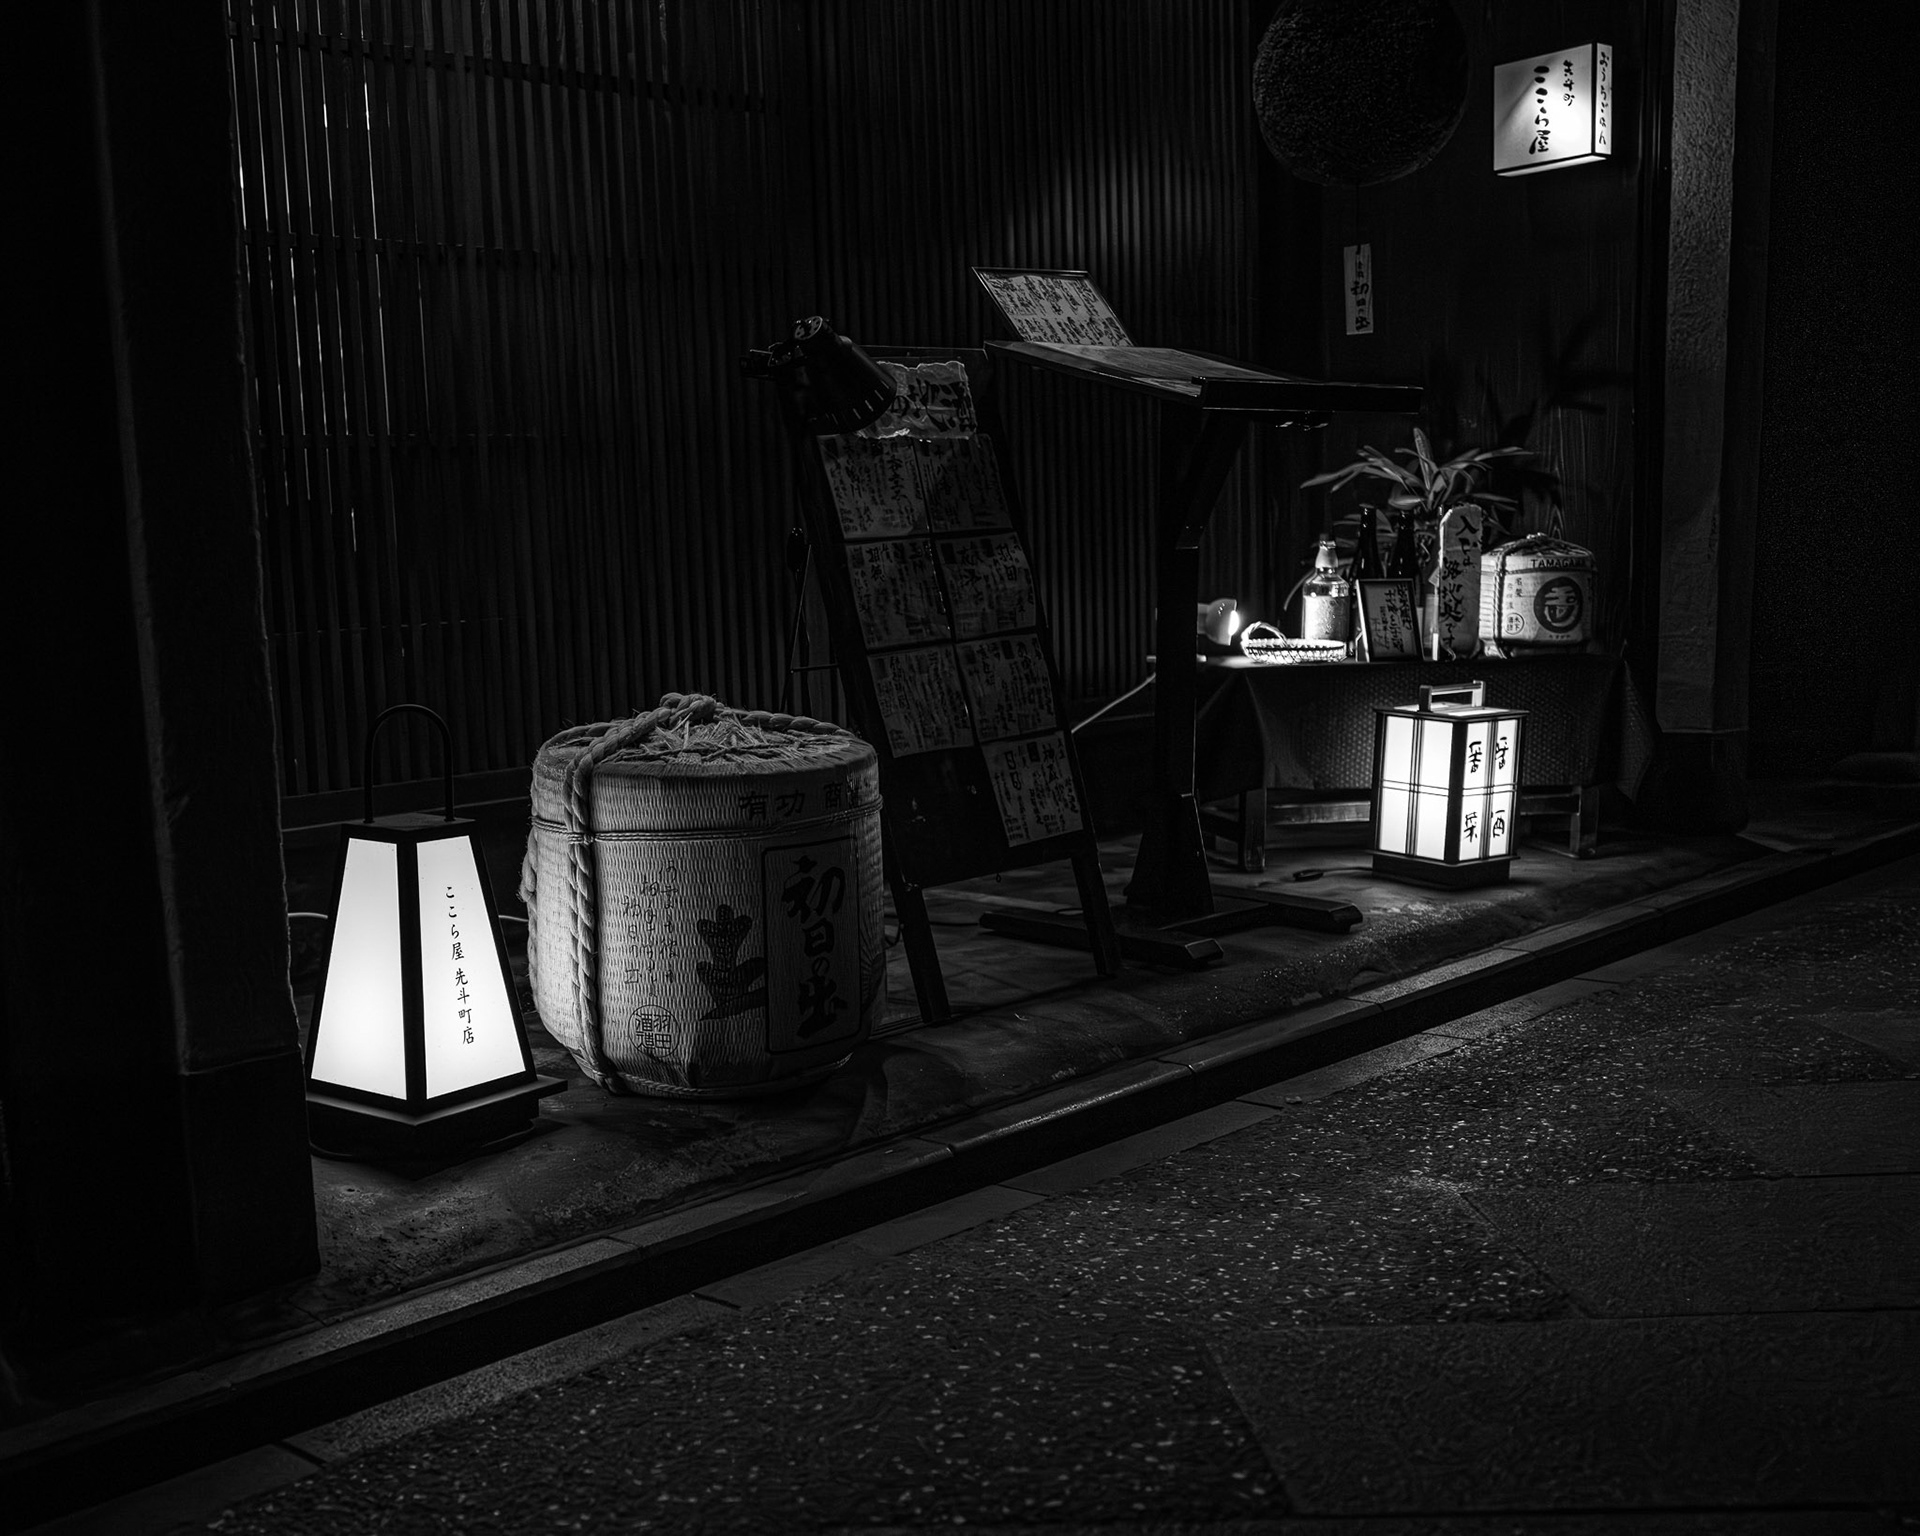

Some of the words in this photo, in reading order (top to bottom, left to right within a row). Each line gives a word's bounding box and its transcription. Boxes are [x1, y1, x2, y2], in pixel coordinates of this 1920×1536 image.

[1529, 65, 1552, 155] ここら屋
[781, 854, 849, 1039] 初日の出
